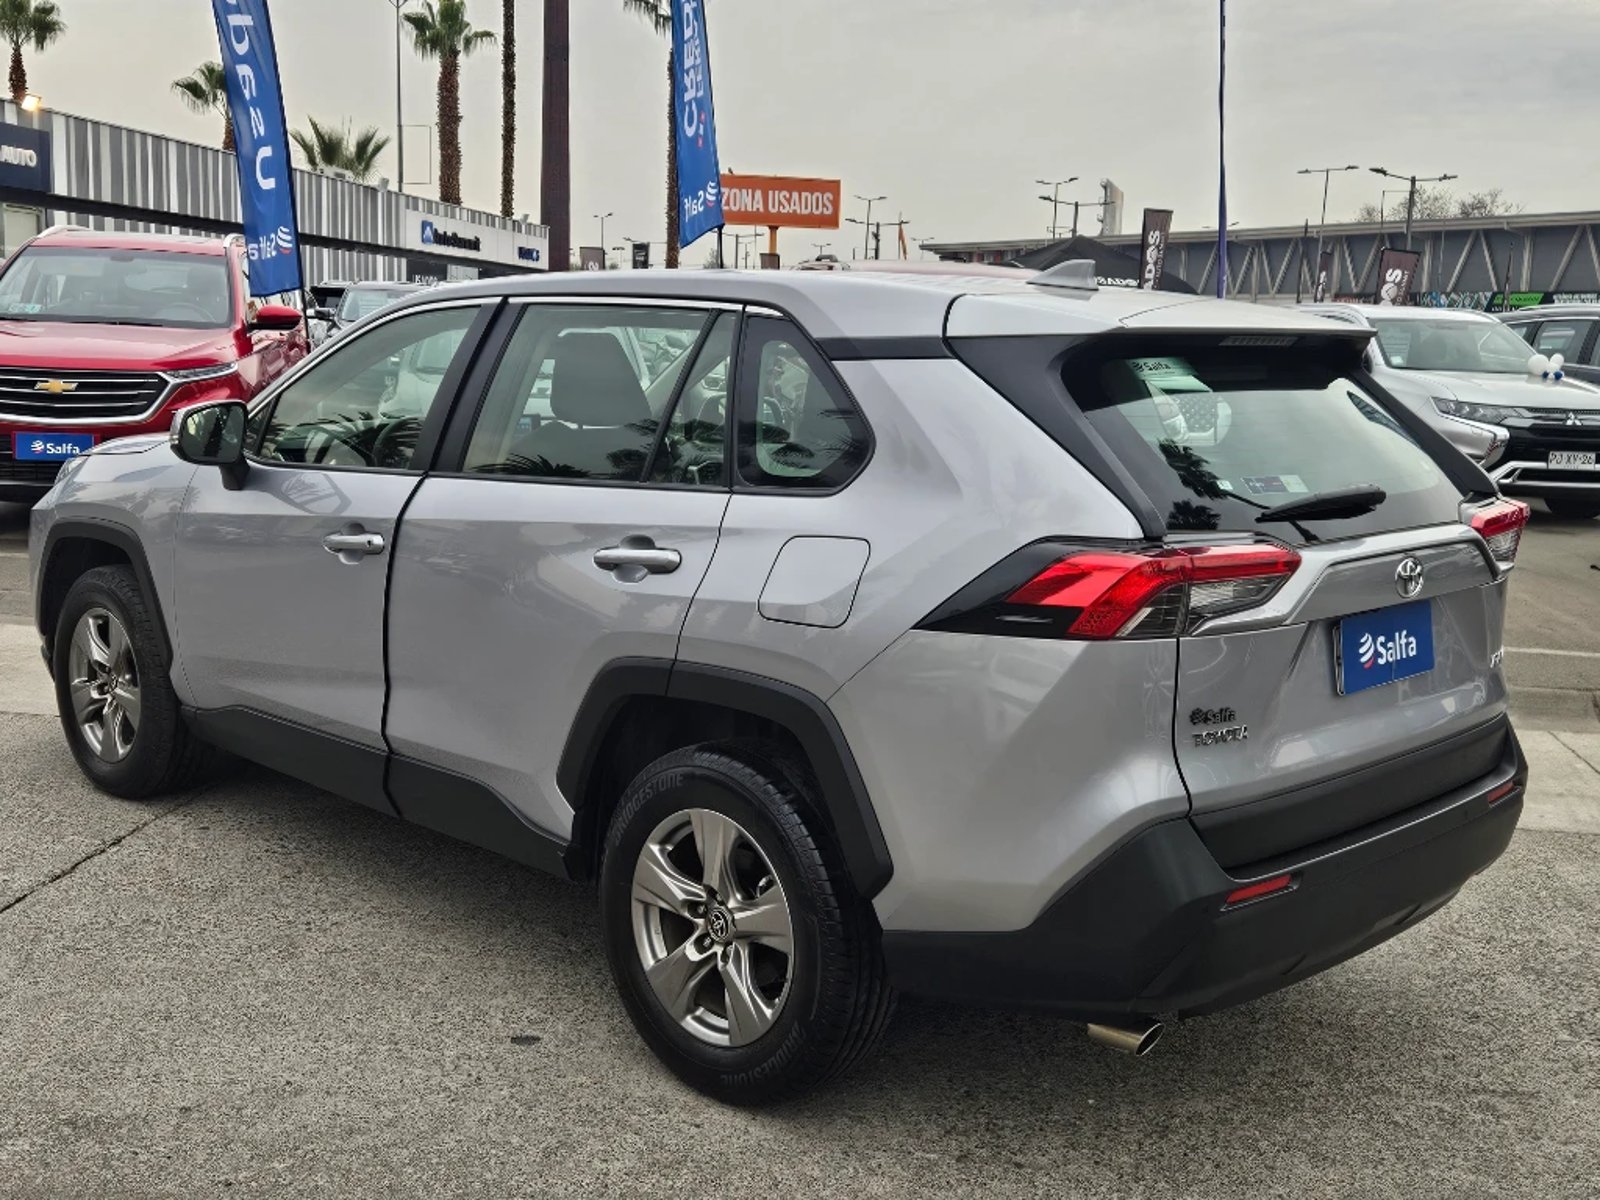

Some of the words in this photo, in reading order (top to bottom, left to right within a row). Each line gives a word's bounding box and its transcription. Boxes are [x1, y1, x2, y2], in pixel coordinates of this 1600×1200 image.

[721, 187, 764, 212] ZONA
[768, 190, 833, 215] USADOS
[46, 443, 80, 454] Salfa
[1376, 629, 1417, 665] Salfa
[1204, 707, 1236, 724] Salfa
[1192, 725, 1248, 747] TOYOTA
